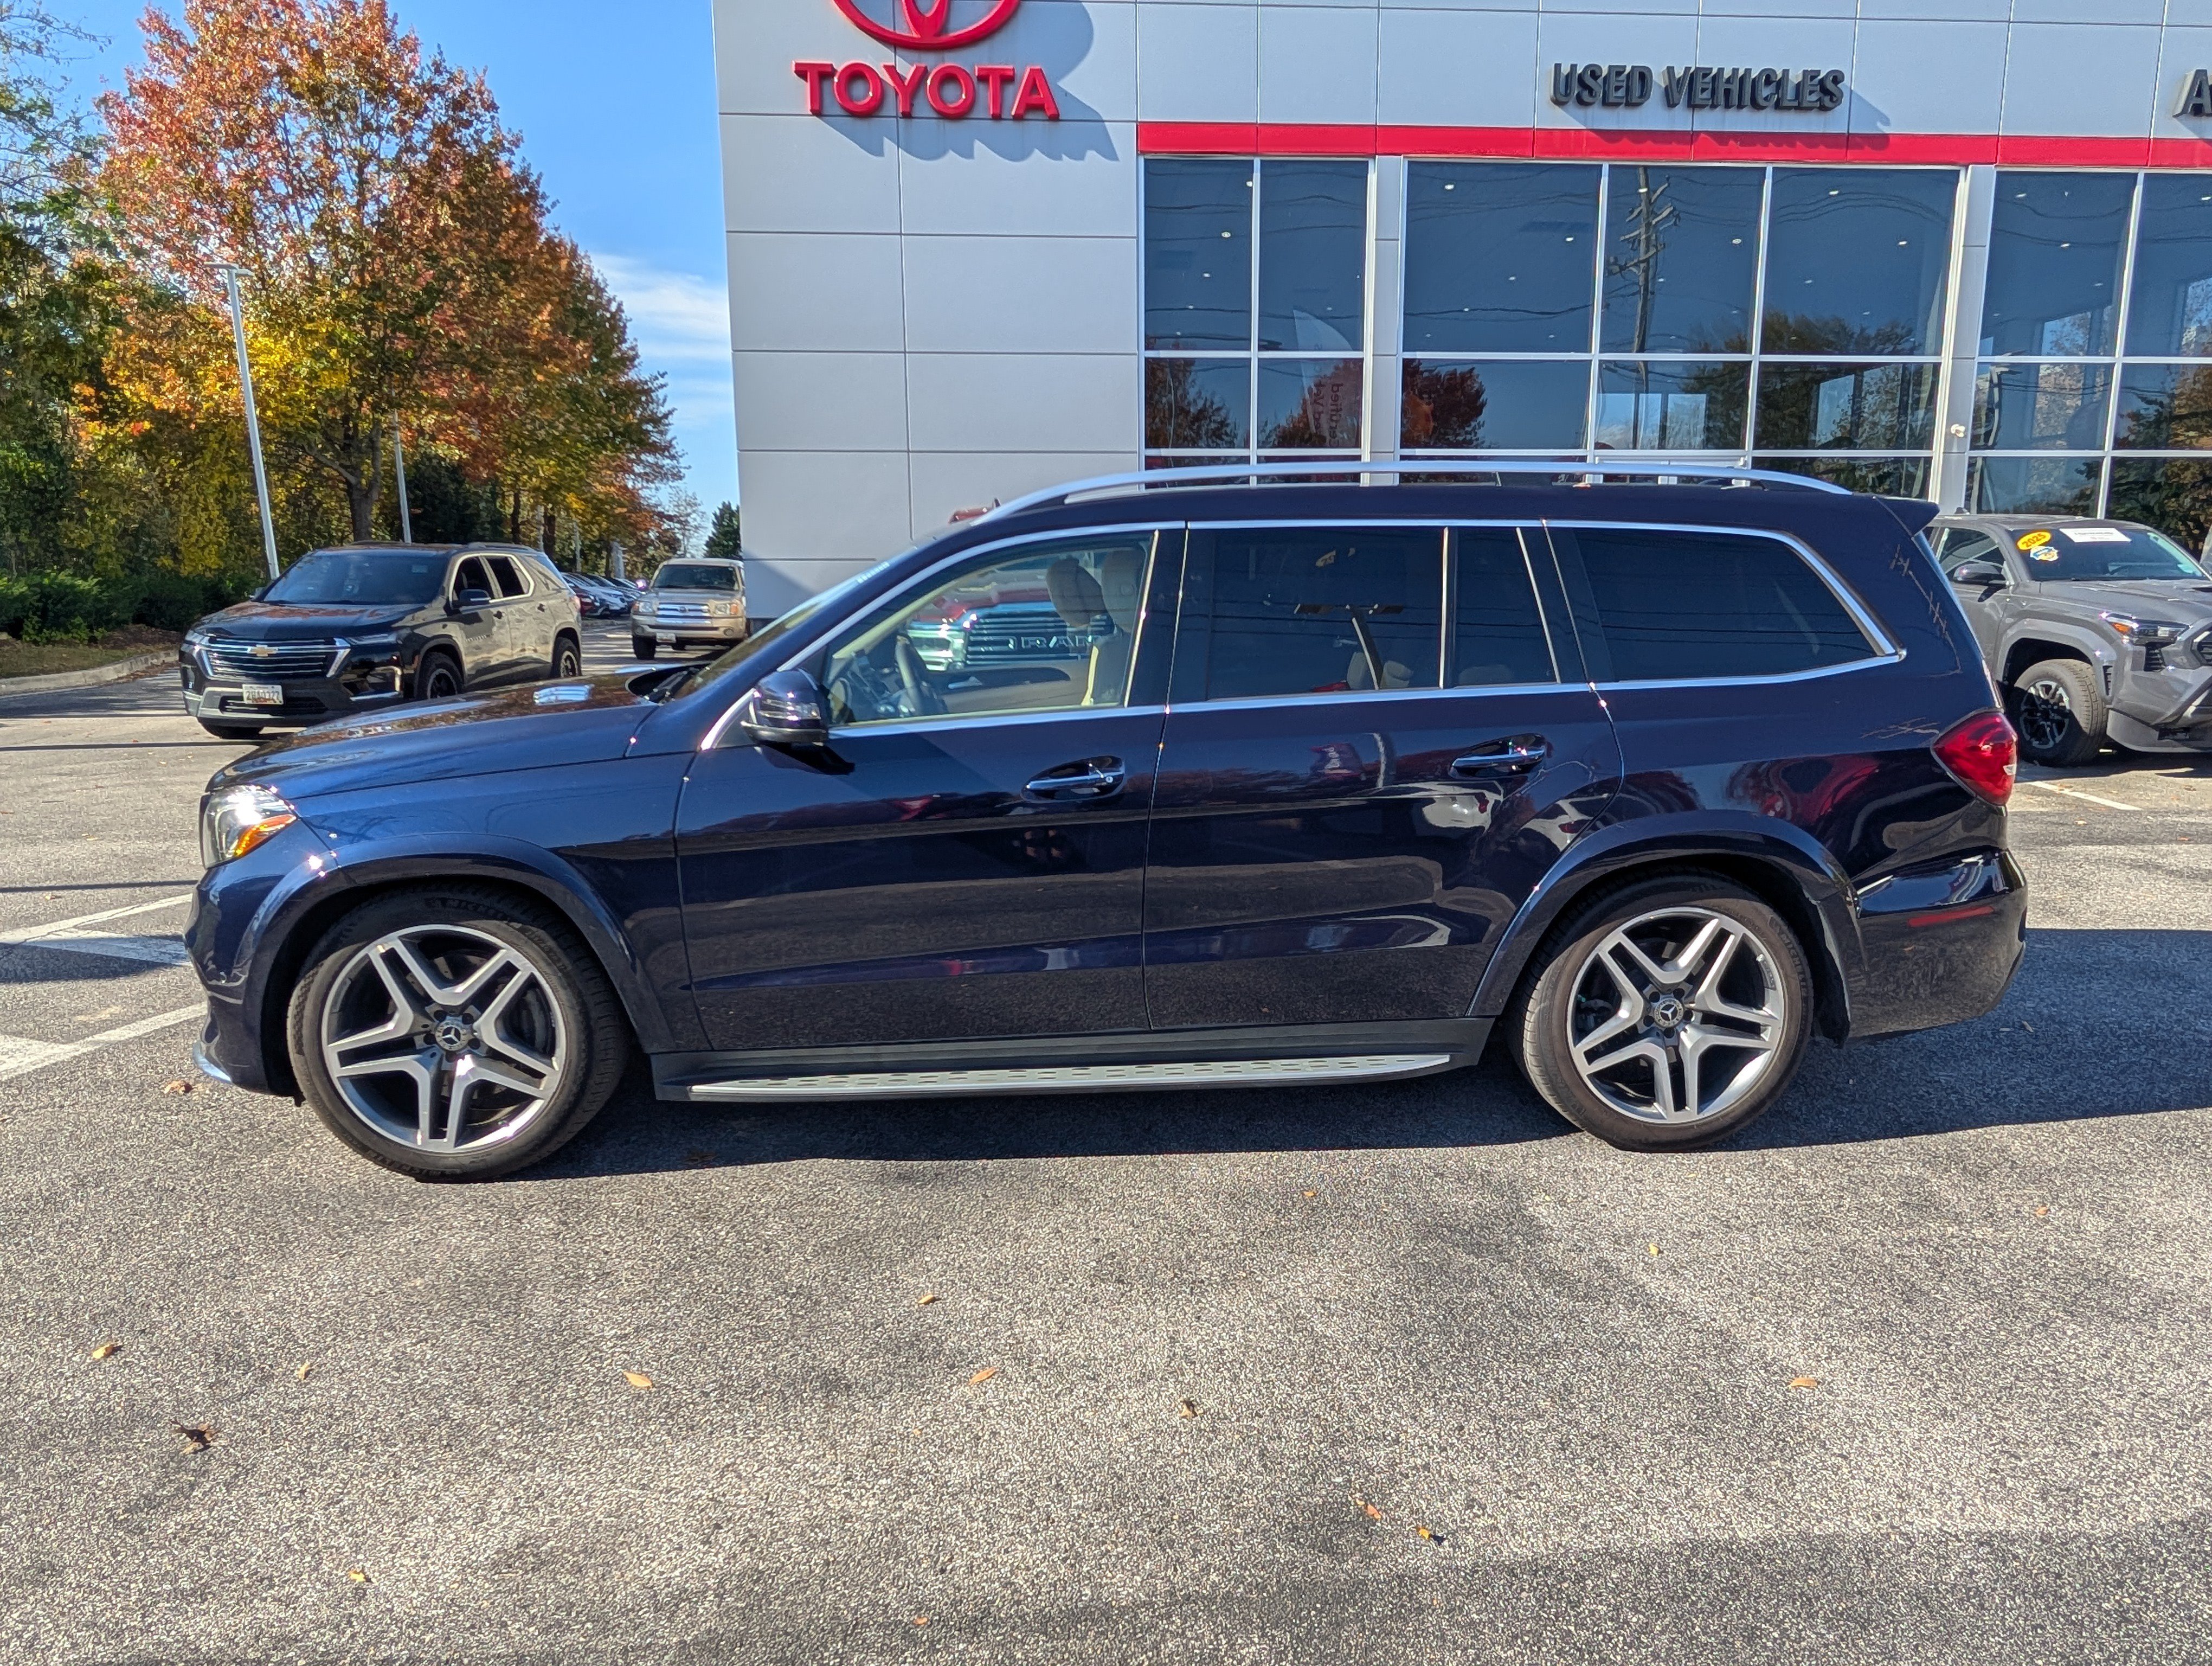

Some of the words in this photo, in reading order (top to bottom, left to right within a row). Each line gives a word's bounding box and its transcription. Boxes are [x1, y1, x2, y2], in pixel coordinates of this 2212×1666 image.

[792, 60, 1060, 120] TOYOTA
[1551, 63, 1653, 106] USED
[1663, 65, 1845, 112] VEHICLES
[2021, 533, 2047, 548] 2025
